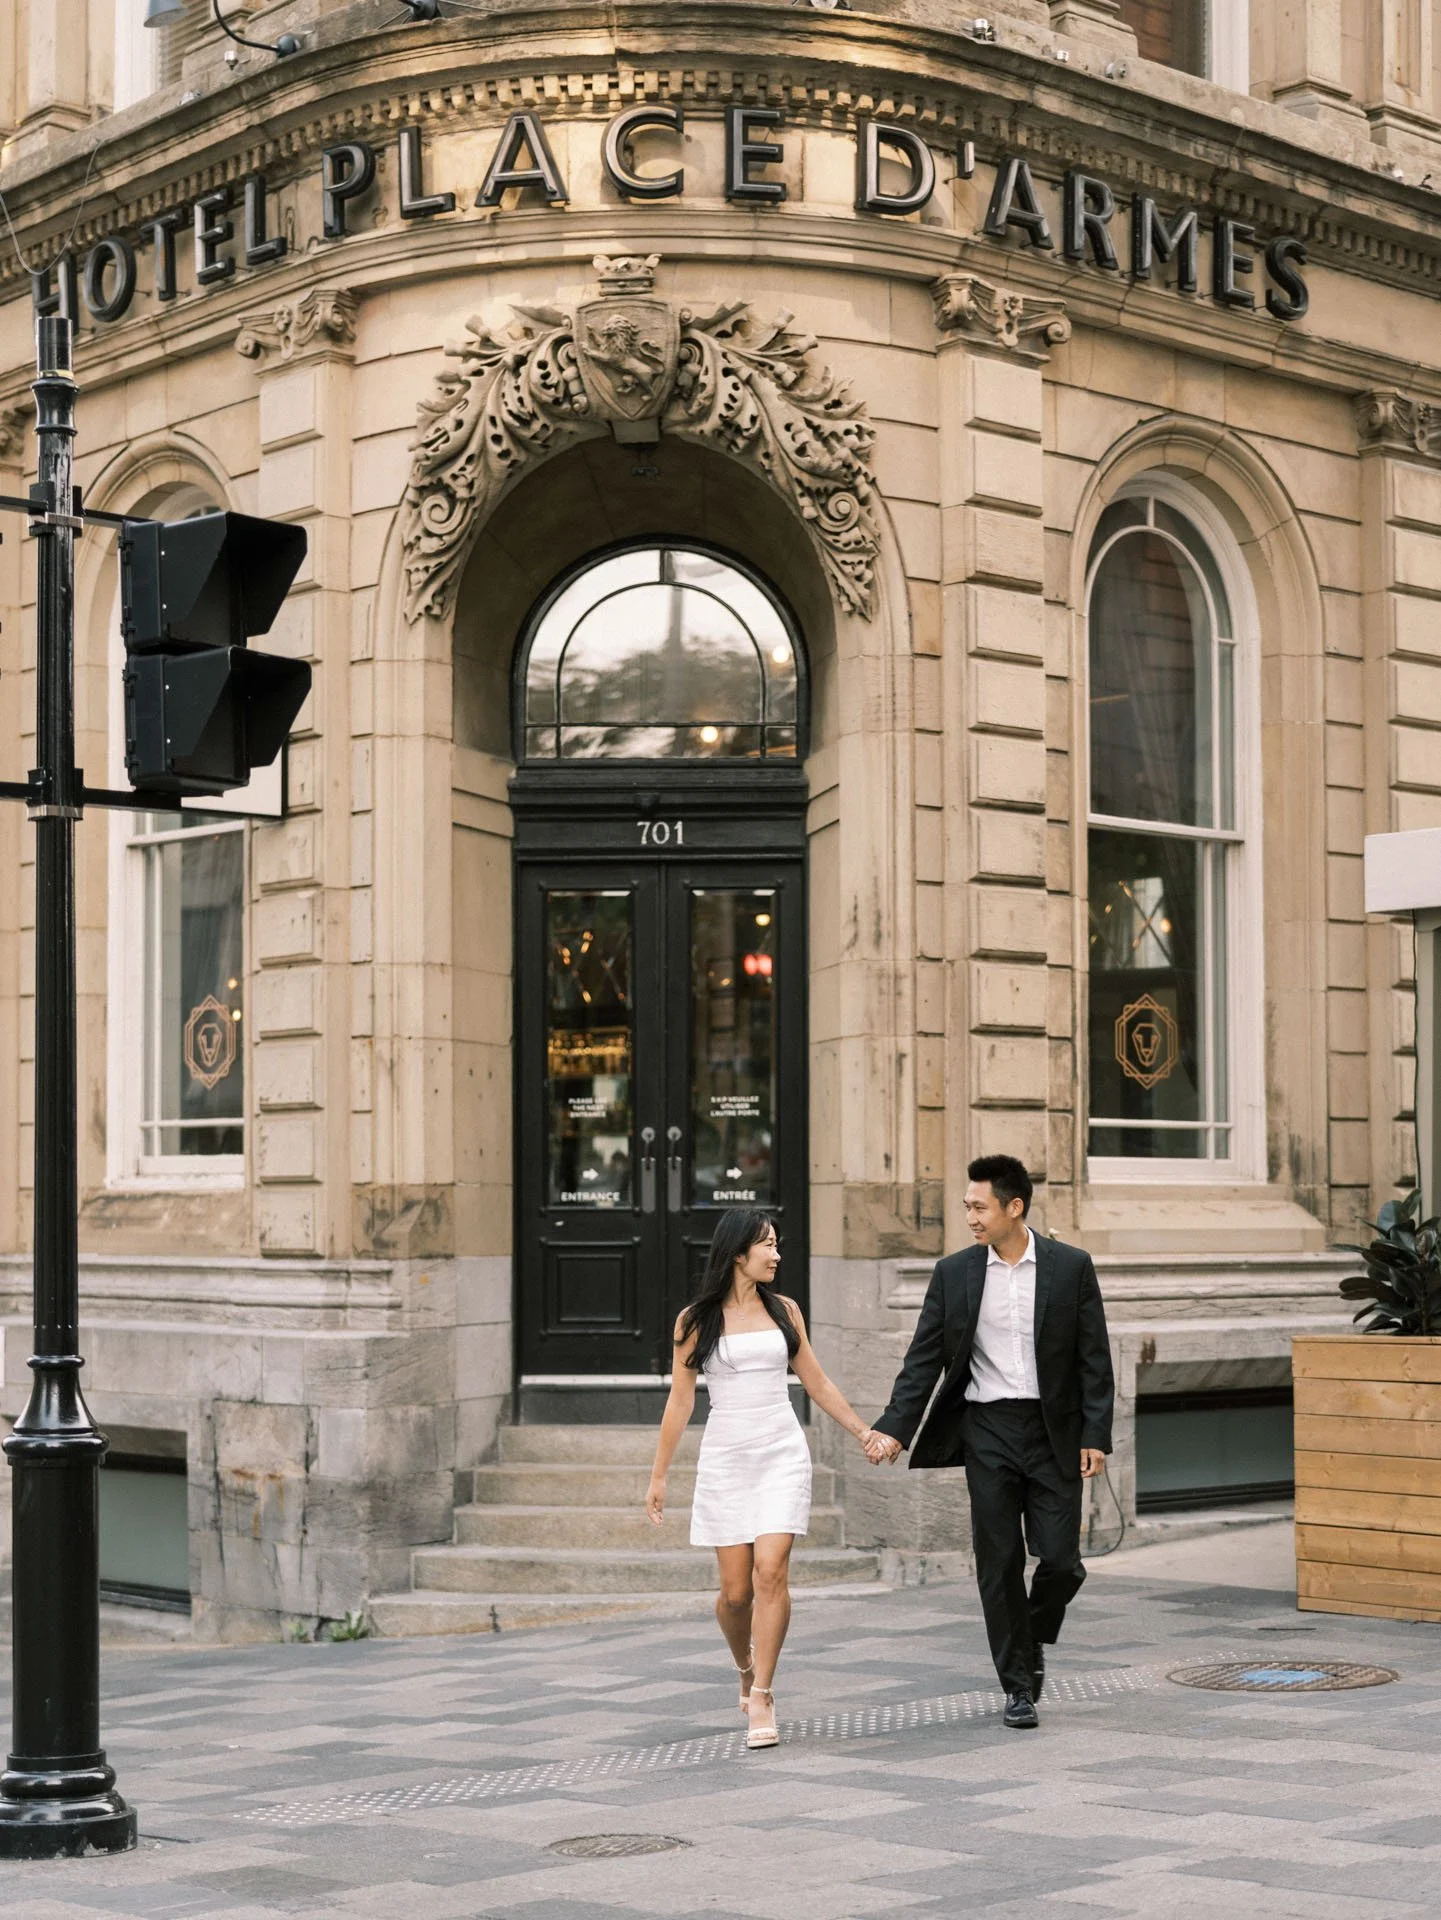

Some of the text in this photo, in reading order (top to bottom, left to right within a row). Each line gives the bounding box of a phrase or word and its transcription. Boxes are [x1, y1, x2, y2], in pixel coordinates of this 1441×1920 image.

[32, 101, 1310, 338] HOTEL PLACE D'ARMES
[636, 820, 685, 845] 701
[561, 1191, 620, 1202] ENTRANCE
[713, 1189, 756, 1201] ENTRÉE
